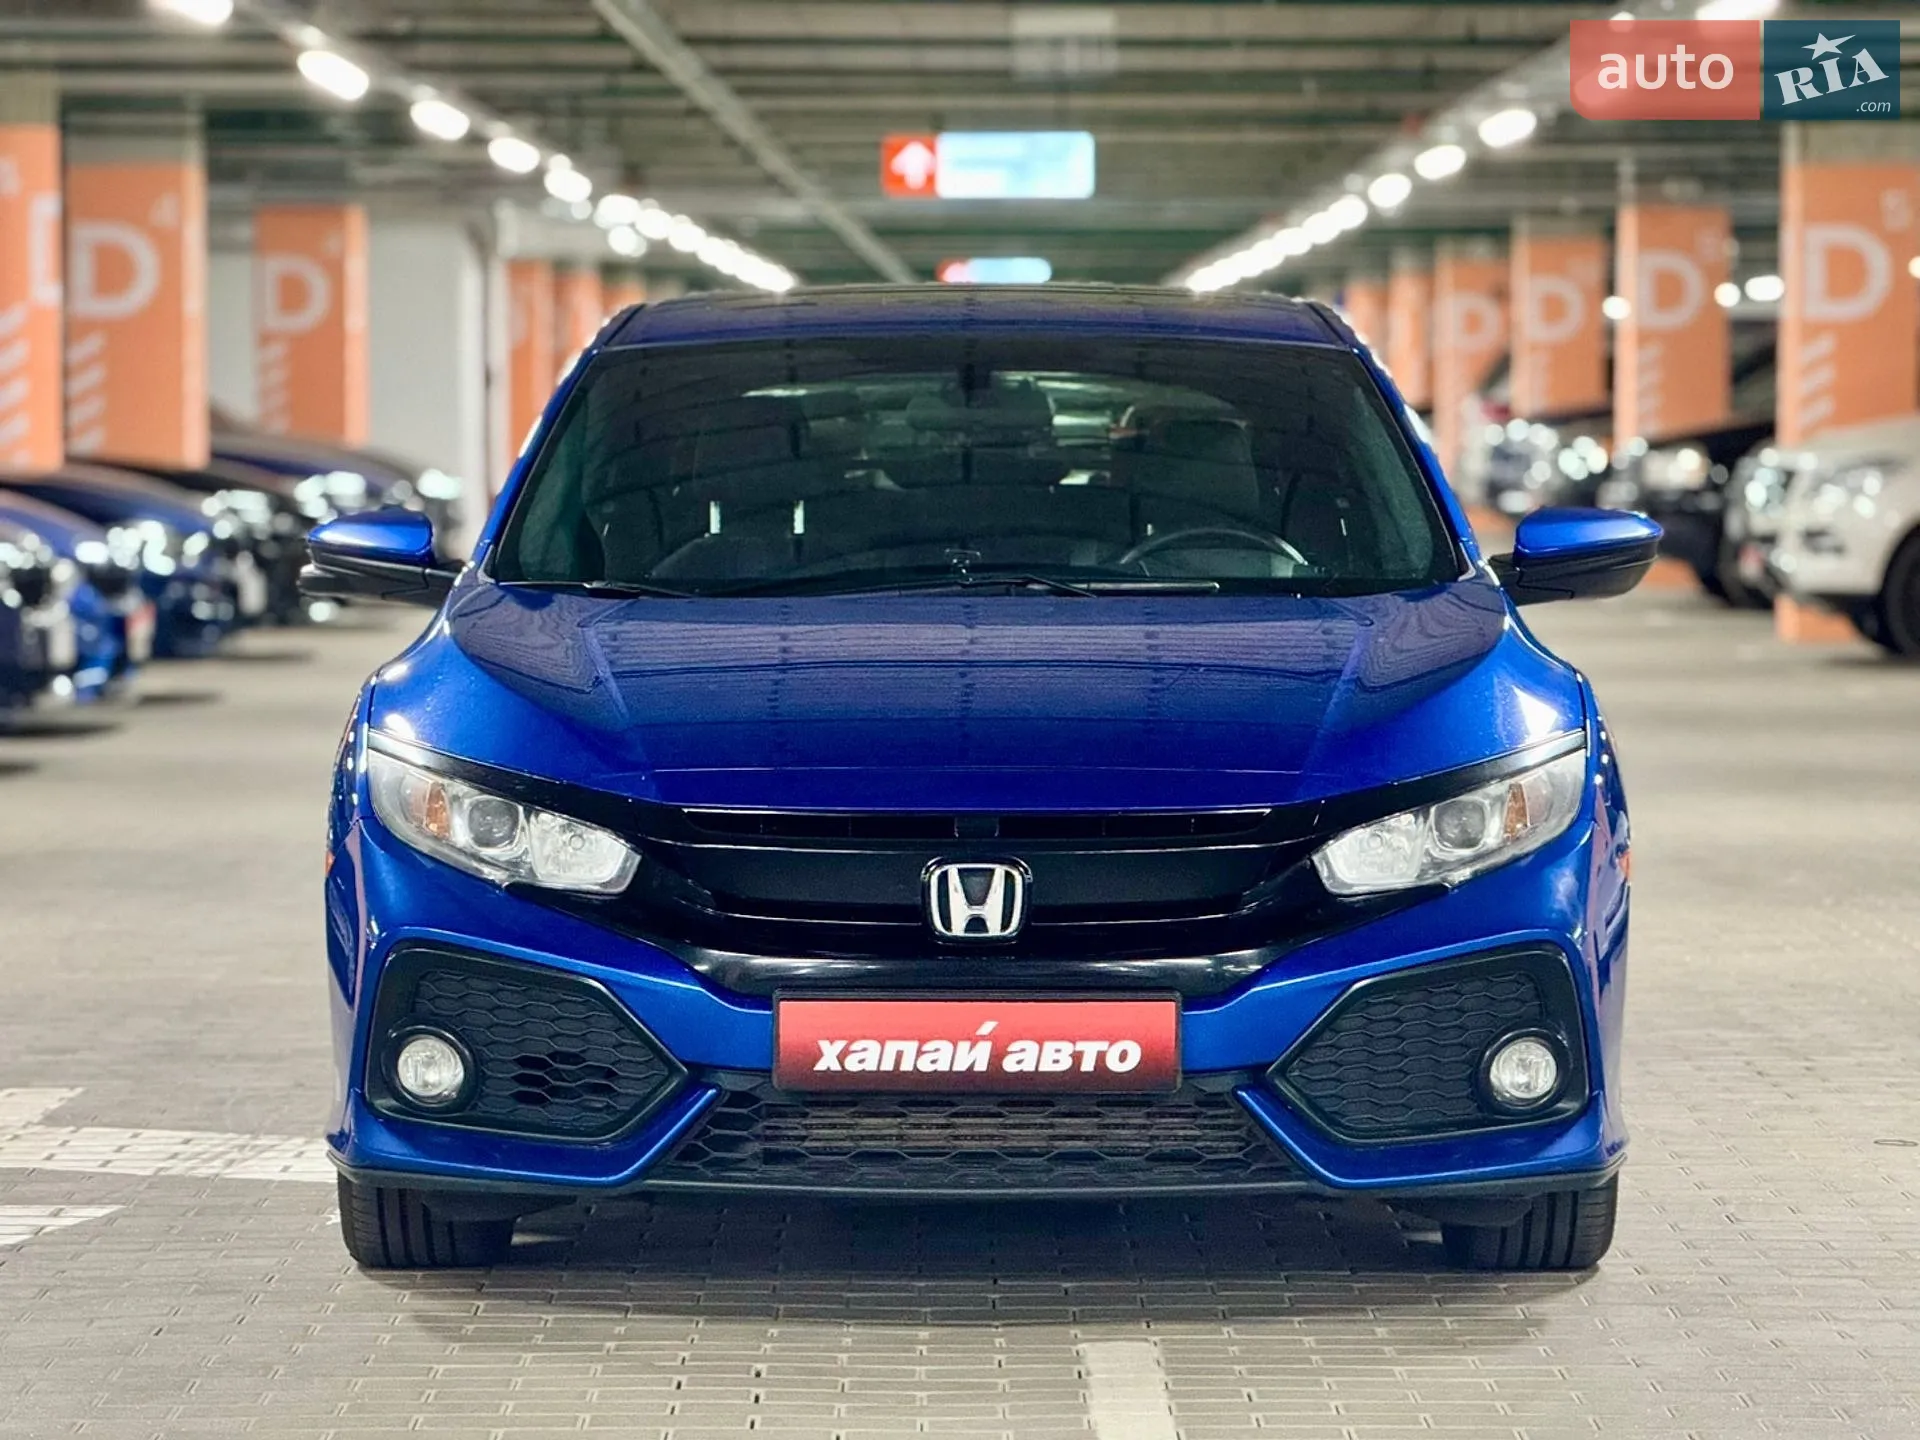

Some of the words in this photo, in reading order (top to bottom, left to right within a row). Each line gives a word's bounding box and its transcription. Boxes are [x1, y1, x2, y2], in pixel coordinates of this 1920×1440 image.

[71, 220, 160, 320] D
[262, 255, 331, 334] D
[1522, 273, 1586, 343] D
[1637, 249, 1706, 331] D
[1800, 224, 1893, 321] D
[1001, 1039, 1142, 1073] авто
